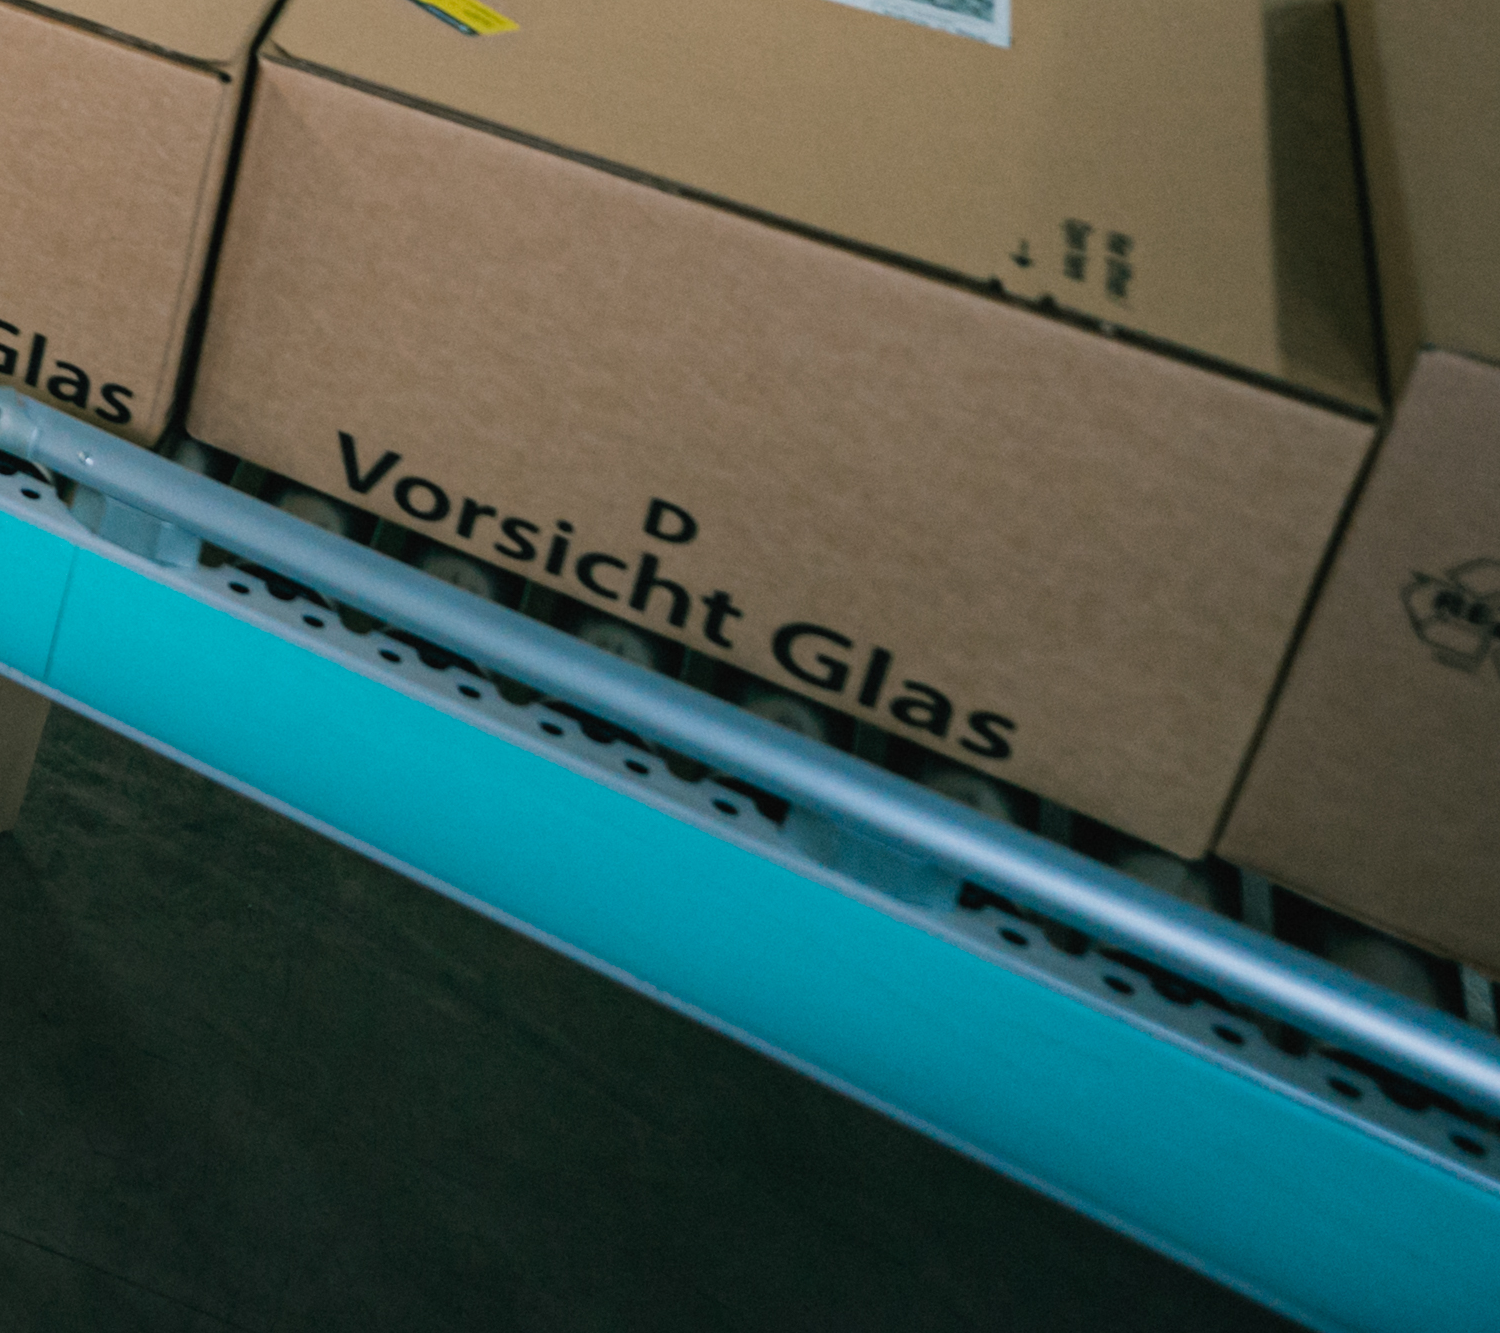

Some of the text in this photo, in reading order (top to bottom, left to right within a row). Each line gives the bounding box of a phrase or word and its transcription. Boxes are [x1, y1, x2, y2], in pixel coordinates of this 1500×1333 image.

[336, 431, 1017, 762] Vorsicht Glas
[643, 498, 698, 544] D
